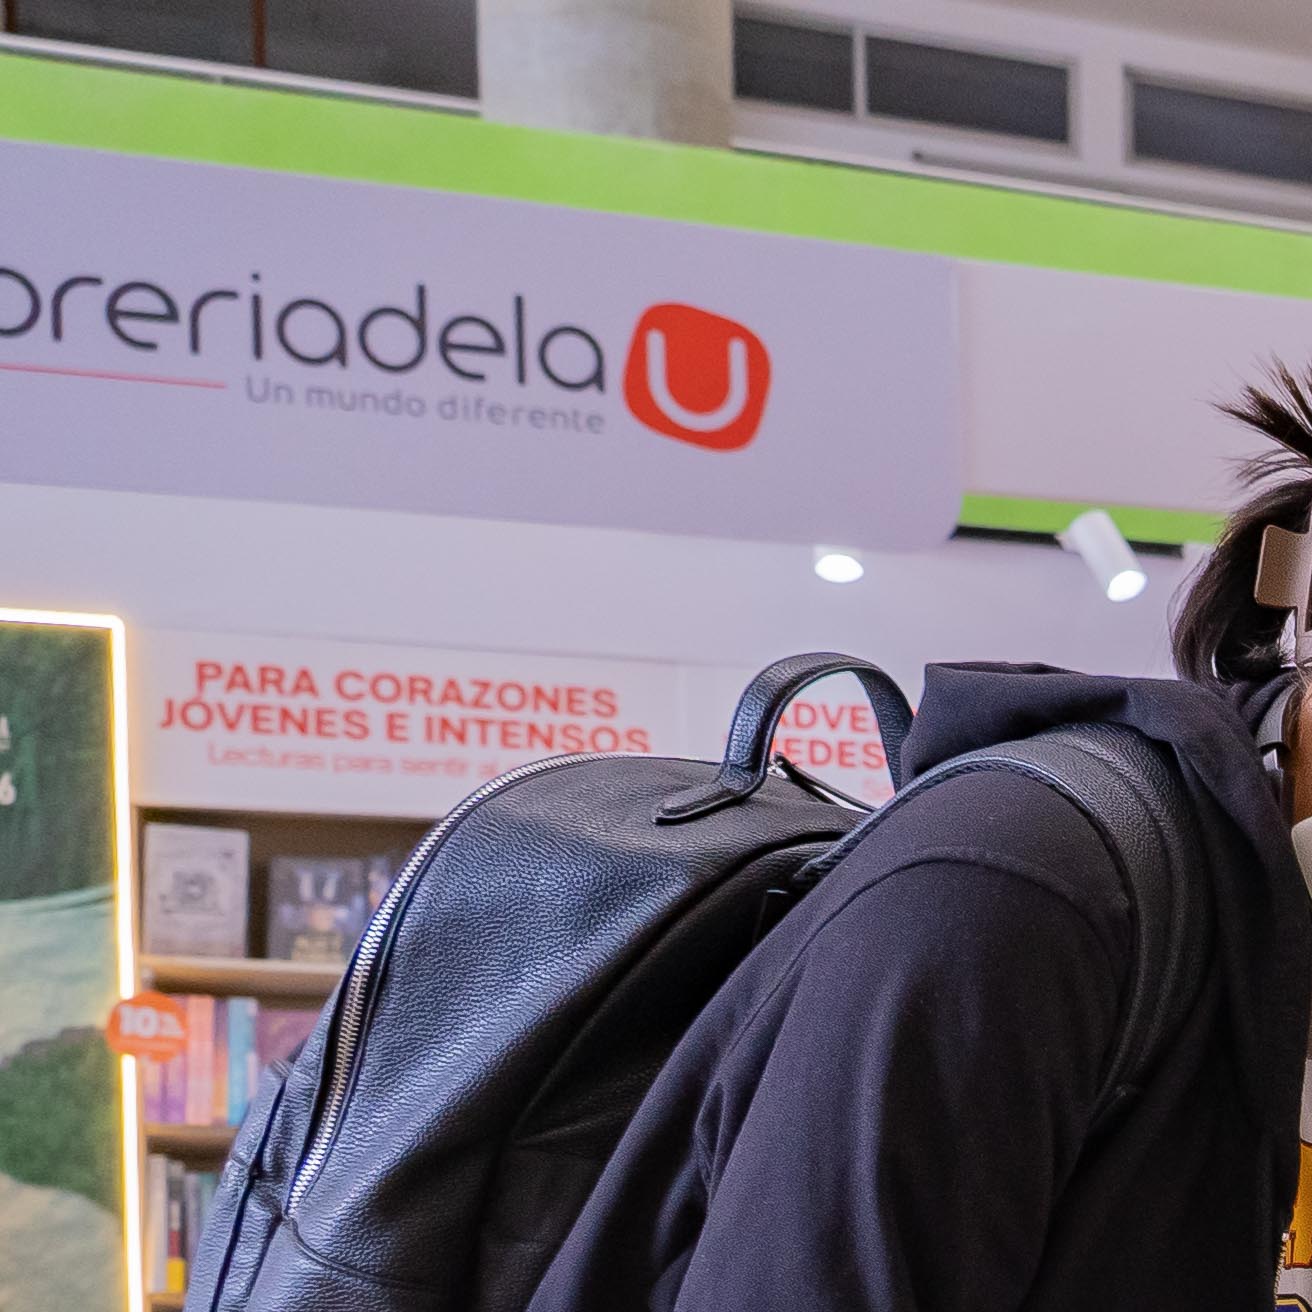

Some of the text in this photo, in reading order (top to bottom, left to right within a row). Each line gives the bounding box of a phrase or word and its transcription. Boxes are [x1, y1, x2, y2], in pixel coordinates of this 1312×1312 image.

[246, 375, 606, 436] Un mundo diferente
[194, 660, 618, 719] PARA CORAZONES
[160, 696, 651, 753] JÓVENES E INTENSOS
[772, 737, 887, 770] EDES
